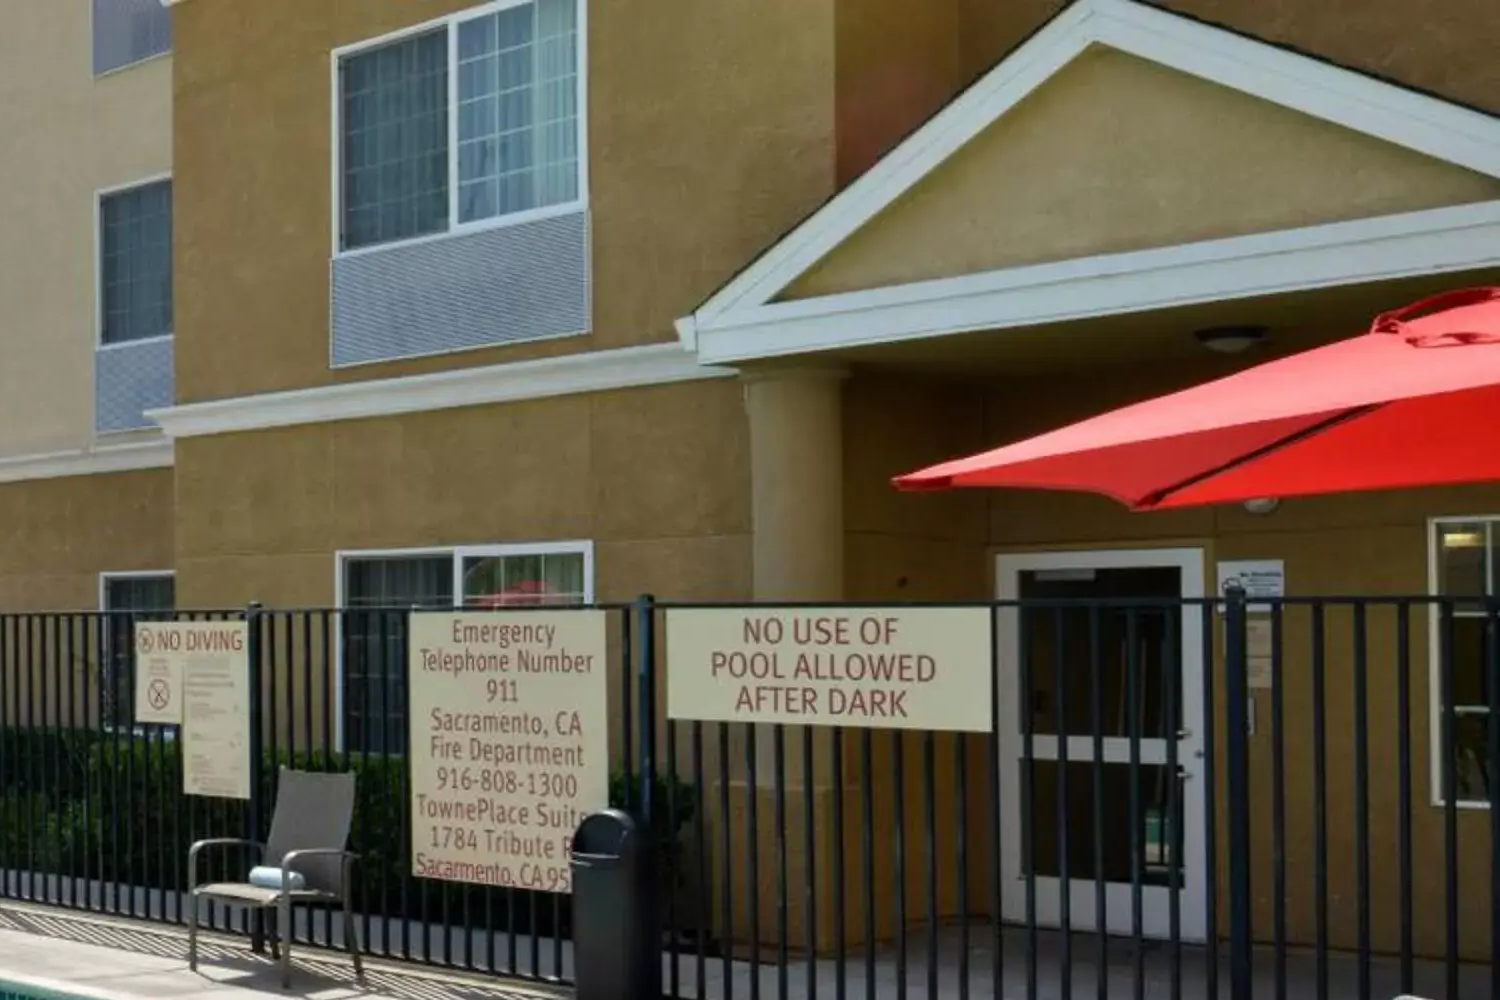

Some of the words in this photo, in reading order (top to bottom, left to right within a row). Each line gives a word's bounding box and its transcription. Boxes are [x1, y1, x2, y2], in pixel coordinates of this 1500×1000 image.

[157, 630, 181, 651] NO
[186, 630, 243, 651] DIVING
[452, 619, 556, 649] Emergency
[743, 618, 783, 645] NO
[793, 617, 850, 645] USE
[860, 617, 900, 646] OF
[419, 649, 510, 678] Telephone
[517, 650, 594, 674] Number
[711, 652, 785, 679] POOL
[793, 653, 937, 682] ALLOWED
[486, 678, 520, 703] 911
[734, 686, 819, 714] AFTER
[828, 688, 908, 718] DARK
[430, 707, 550, 739] Sacramento,
[555, 710, 583, 737] CA
[430, 734, 463, 760] Fire
[469, 738, 586, 768] Department
[436, 766, 578, 799] 916-808-1300
[416, 793, 530, 826] TownePlace
[430, 825, 478, 851] 1784
[484, 829, 555, 859] Tribute
[520, 861, 544, 888] CA
